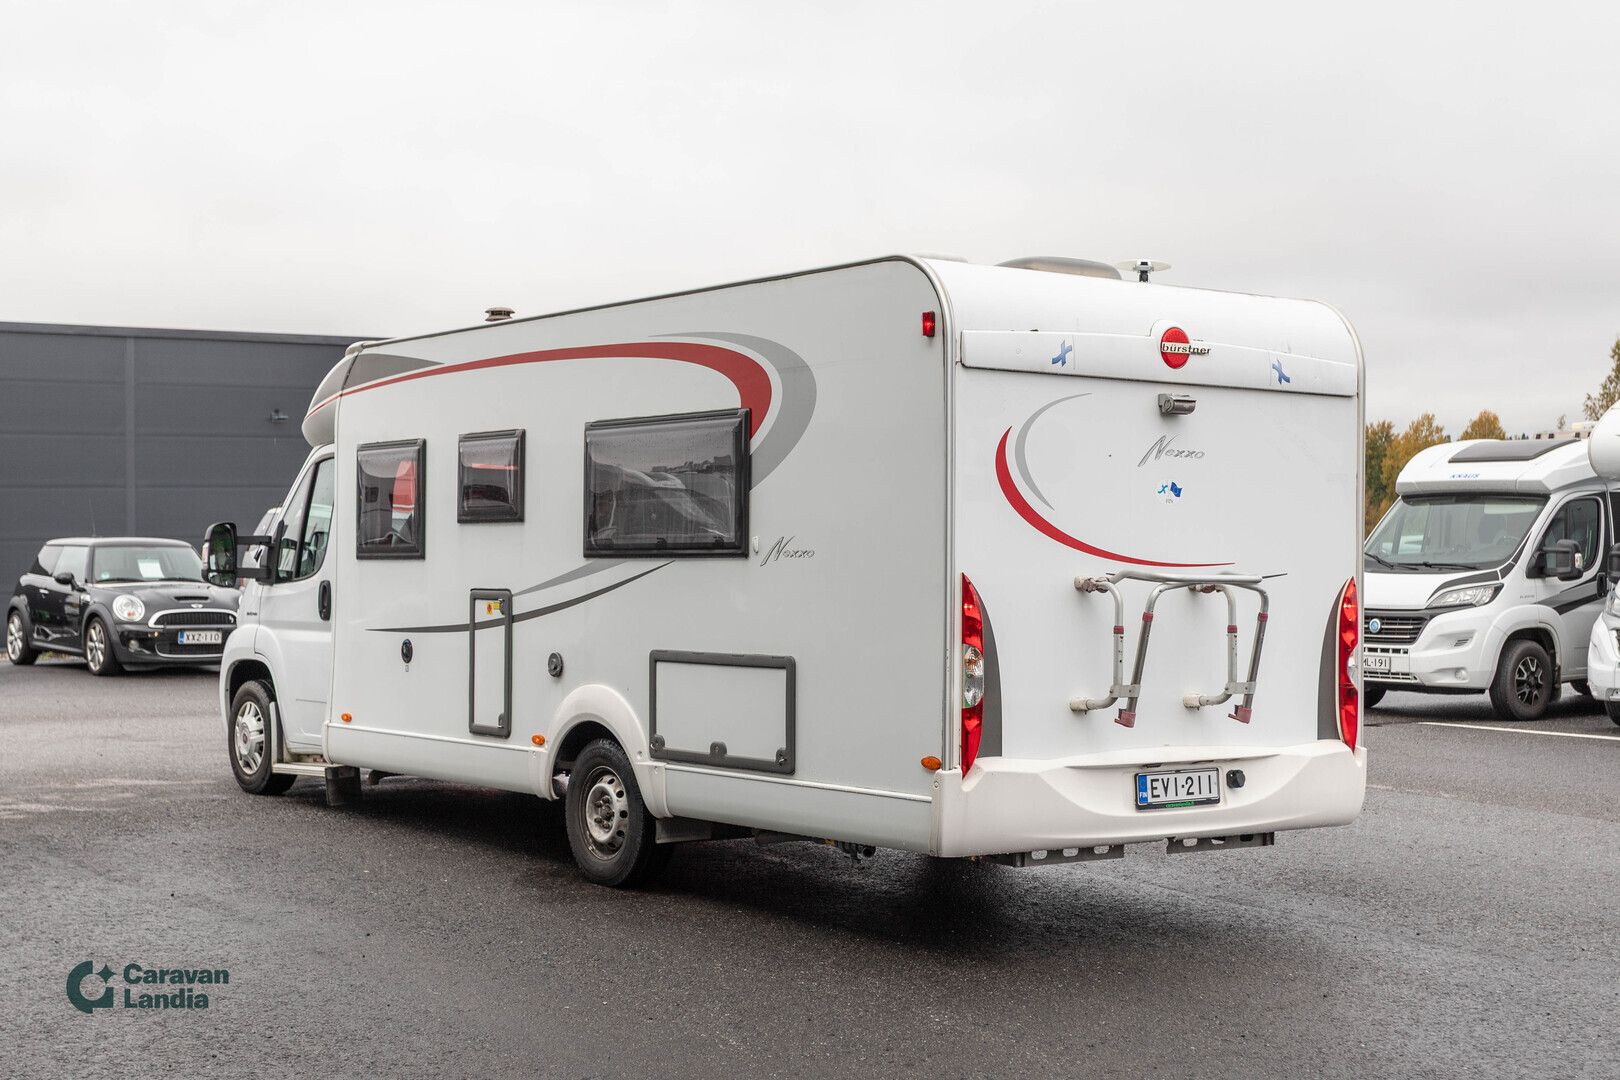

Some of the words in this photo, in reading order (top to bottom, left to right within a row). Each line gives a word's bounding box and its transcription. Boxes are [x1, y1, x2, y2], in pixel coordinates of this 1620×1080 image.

[1162, 343, 1211, 355] bürstner
[1138, 434, 1205, 467] Nexxo
[760, 535, 815, 567] Nexxo
[1150, 774, 1212, 798] EVI-211
